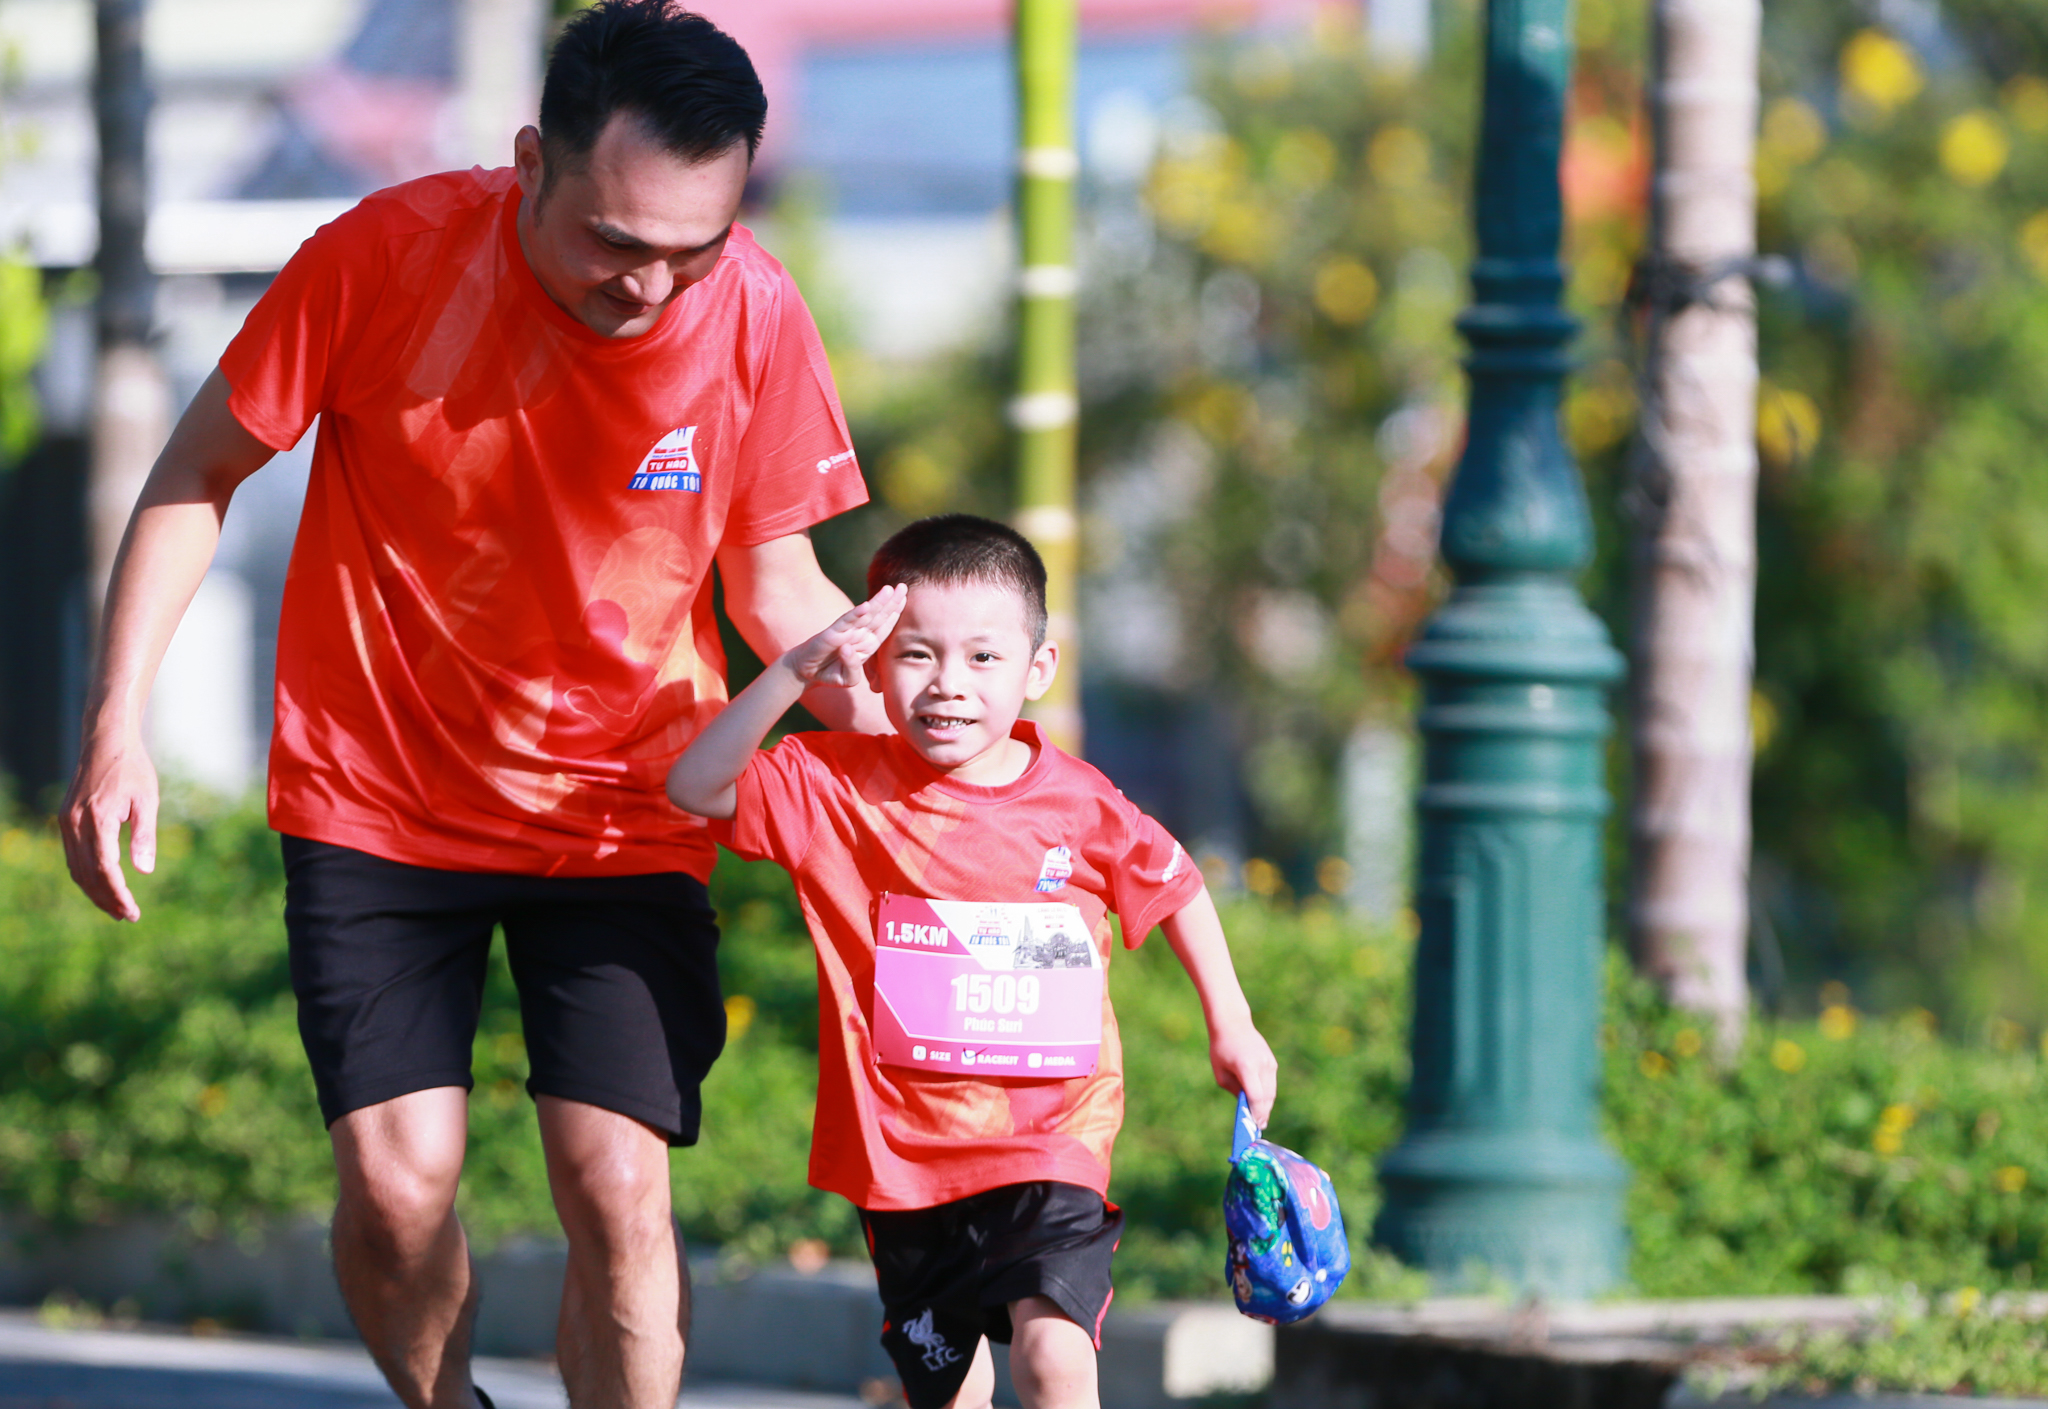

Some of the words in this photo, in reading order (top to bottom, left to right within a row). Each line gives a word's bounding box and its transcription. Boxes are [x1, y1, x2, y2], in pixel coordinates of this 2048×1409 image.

[886, 921, 949, 948] 1,5KM
[951, 974, 1040, 1015] 1509
[964, 1017, 995, 1032] Phúc
[929, 1051, 951, 1062] SIZE
[977, 1054, 1019, 1065] RACEKIT
[1044, 1056, 1076, 1066] MEDAL
